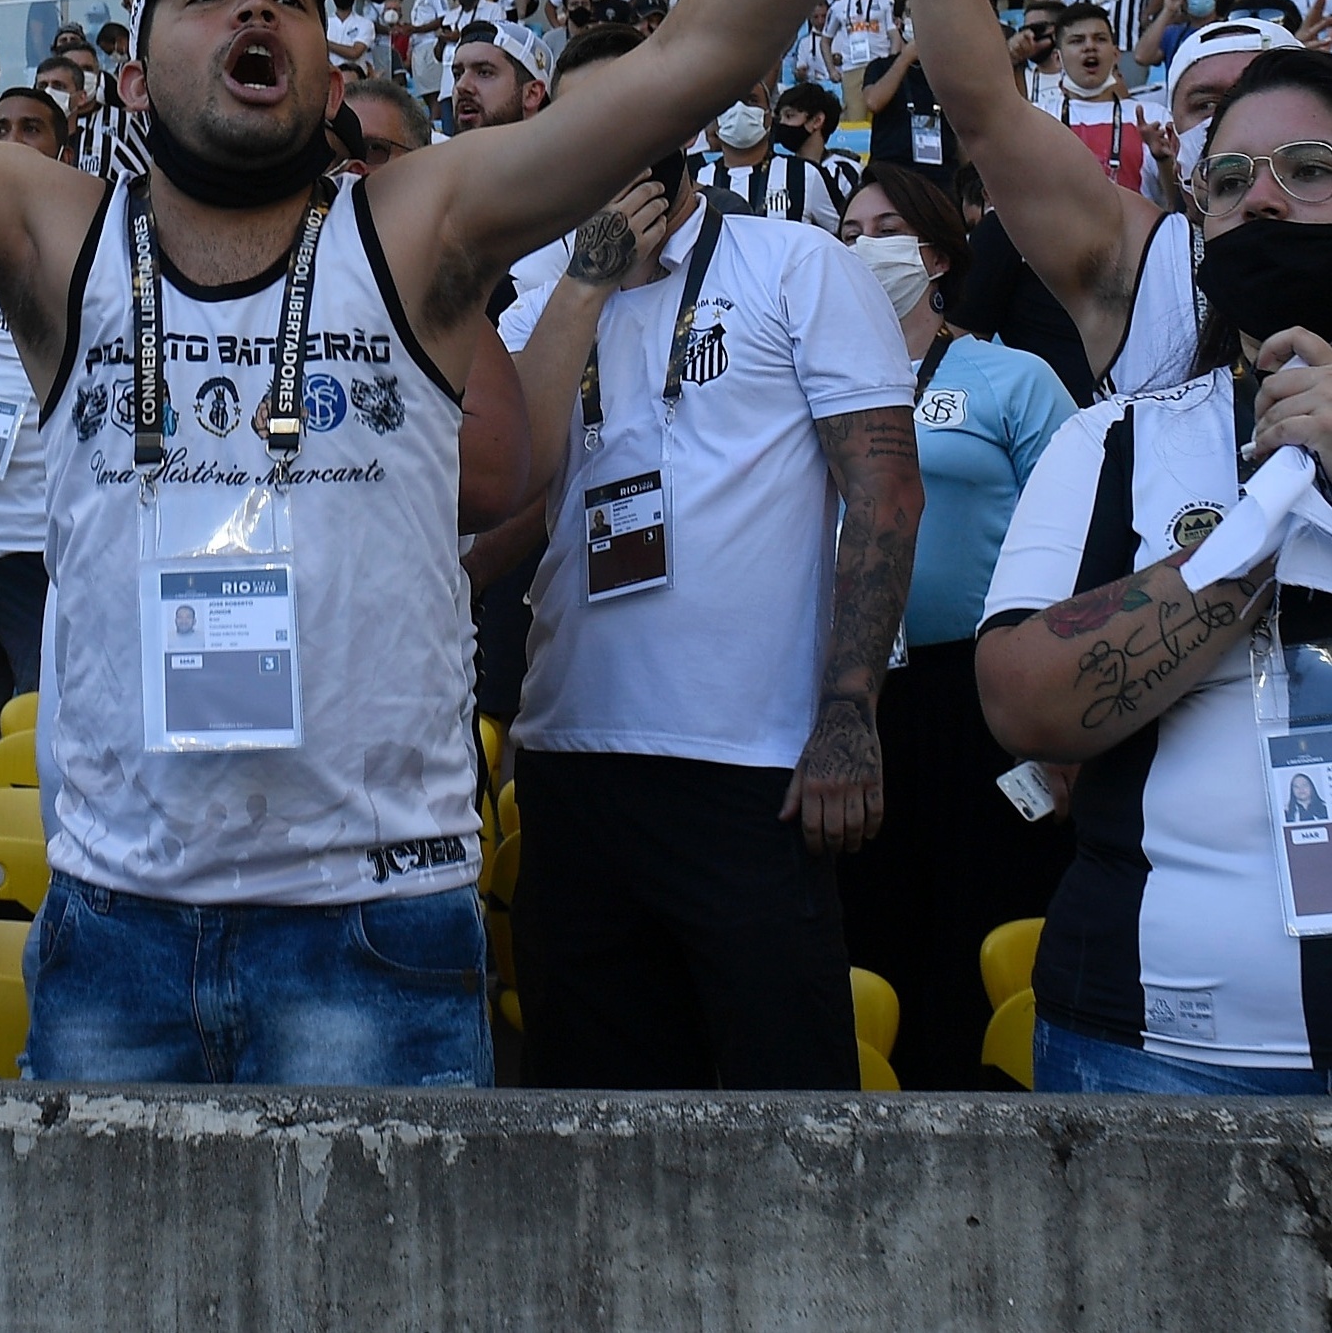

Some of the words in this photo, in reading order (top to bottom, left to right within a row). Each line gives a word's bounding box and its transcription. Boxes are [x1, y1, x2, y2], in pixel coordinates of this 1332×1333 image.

[133, 213, 156, 325] LIBERTADORES
[292, 207, 323, 290] CONMEBOL
[278, 284, 306, 414] LIBERTADORES
[141, 326, 156, 426] CONMEBOL
[620, 485, 638, 497] RIO
[222, 581, 251, 595] RIO
[253, 585, 277, 594] 2020
[265, 657, 275, 671] 3
